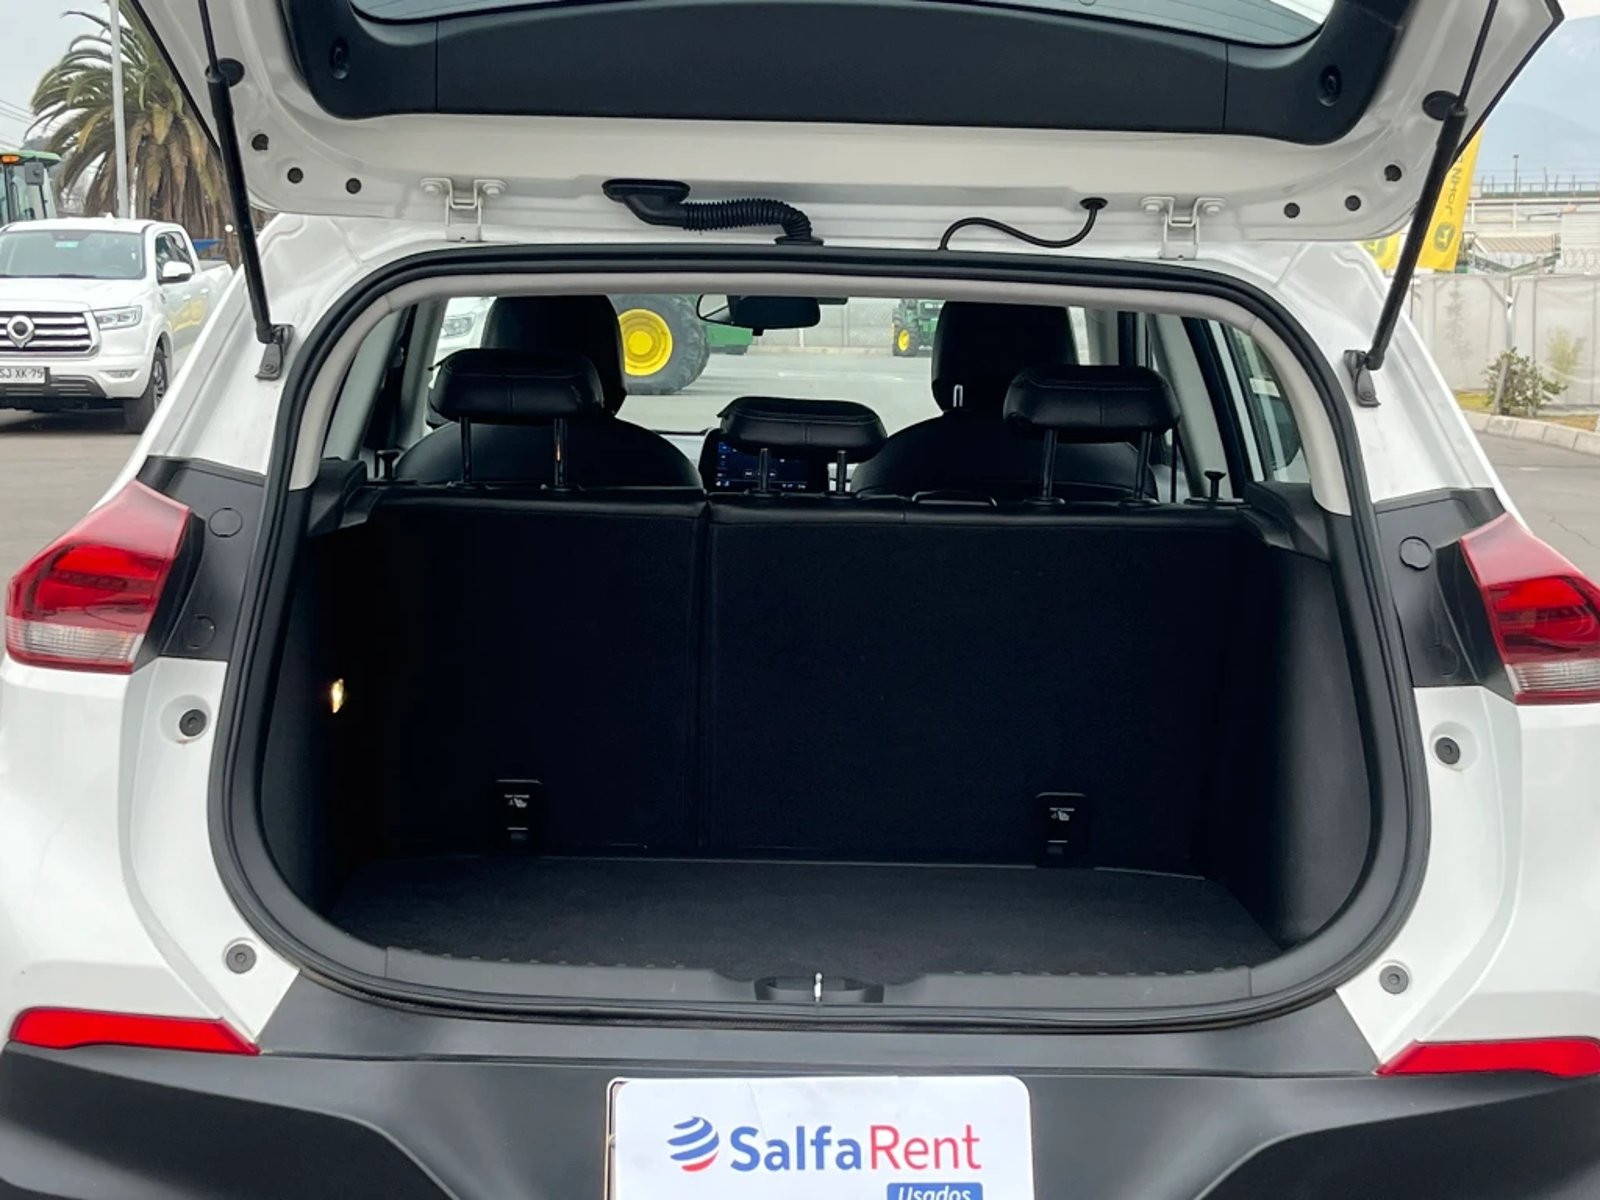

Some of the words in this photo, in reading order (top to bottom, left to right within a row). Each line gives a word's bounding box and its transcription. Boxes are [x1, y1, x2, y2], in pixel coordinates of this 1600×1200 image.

[1445, 167, 1463, 216] JOHN
[729, 1123, 983, 1173] SalfaRent
[898, 1185, 972, 1200] Usados
